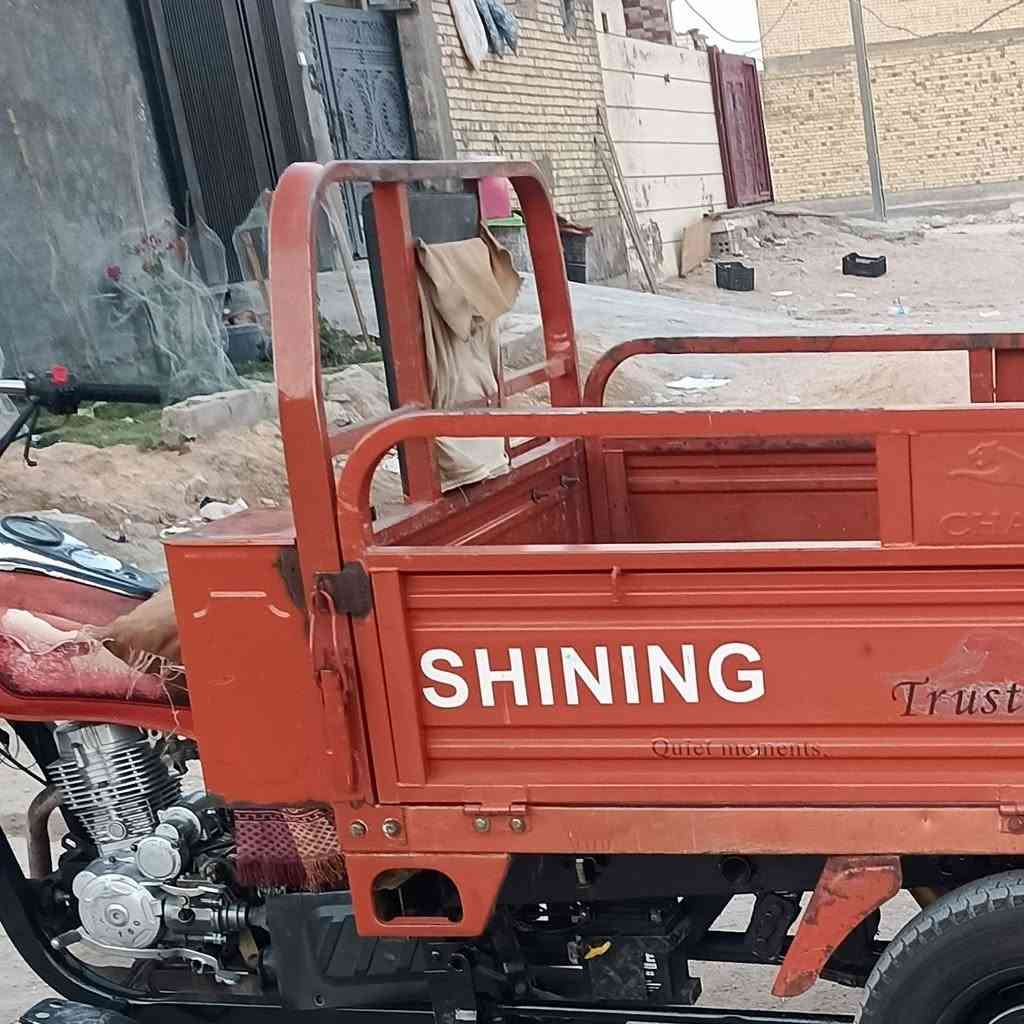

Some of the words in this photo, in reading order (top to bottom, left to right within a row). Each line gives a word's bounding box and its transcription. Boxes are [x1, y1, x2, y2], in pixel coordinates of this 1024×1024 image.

[420, 642, 766, 709] SHINING
[892, 676, 1023, 717] Trust
[650, 737, 713, 759] Quiet
